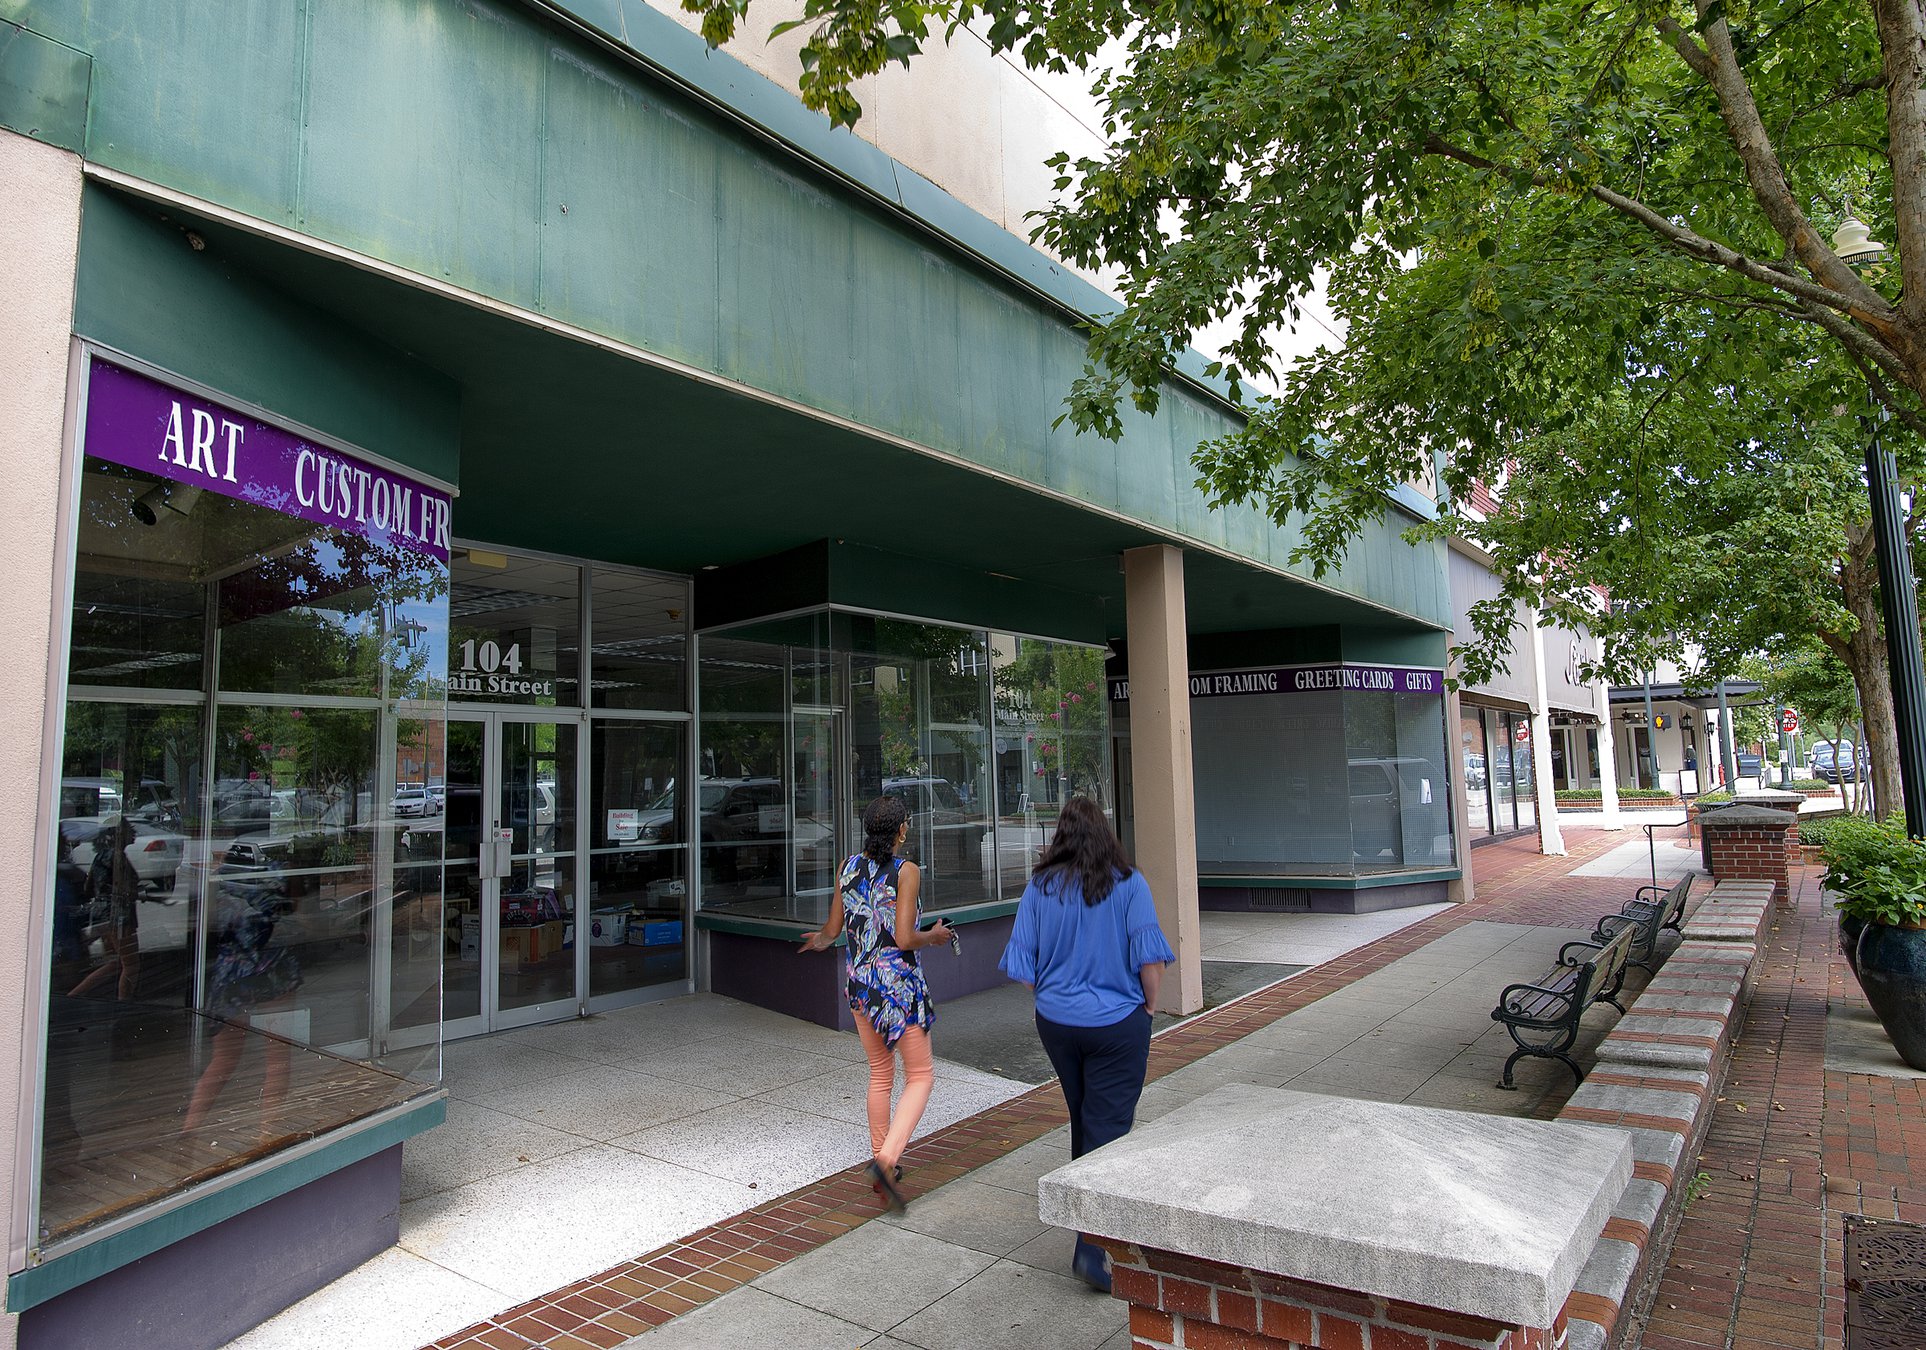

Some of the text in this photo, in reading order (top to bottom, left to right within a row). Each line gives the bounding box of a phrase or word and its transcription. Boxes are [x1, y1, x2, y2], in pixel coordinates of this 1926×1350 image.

[158, 401, 245, 484] ART
[295, 449, 412, 537] CUSTOM
[459, 639, 523, 674] 104
[447, 673, 552, 695] ain Street
[1113, 669, 1432, 699] AR OM FRAMING GREETING CARDS GIFTS
[1008, 689, 1032, 708] 104
[1019, 710, 1045, 721] Street
